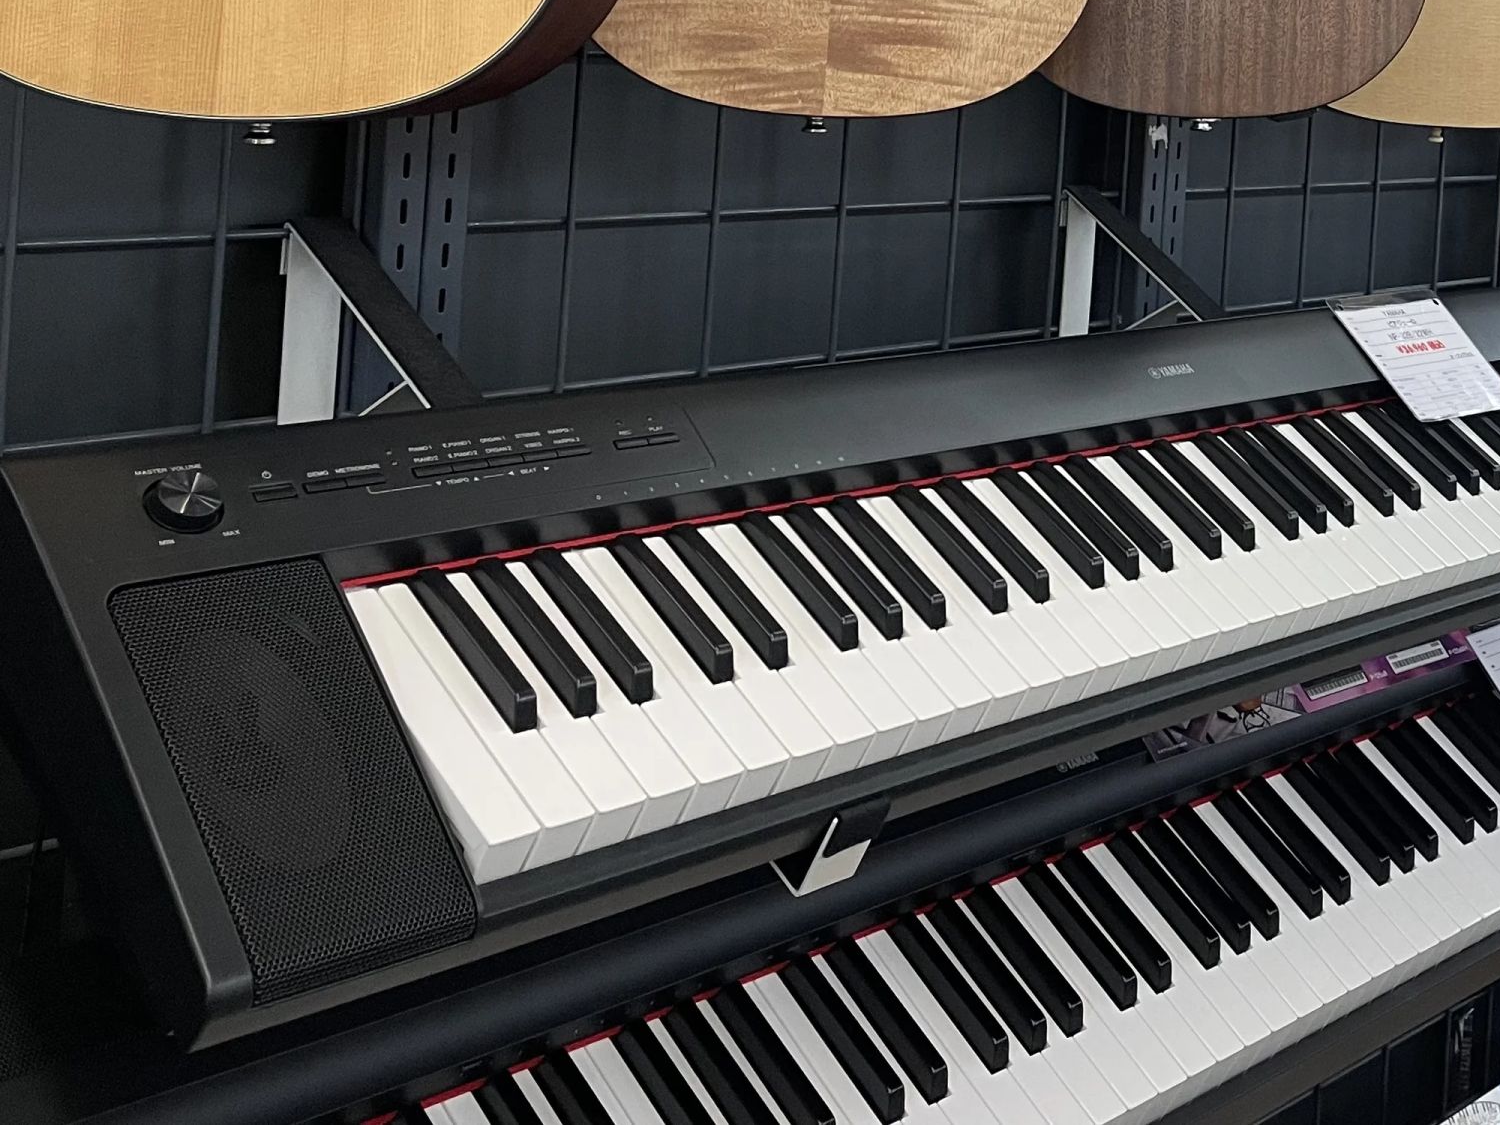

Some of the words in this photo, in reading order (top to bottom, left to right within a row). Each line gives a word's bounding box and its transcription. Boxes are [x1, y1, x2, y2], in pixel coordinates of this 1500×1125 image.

[1158, 363, 1195, 377] YAMAHA
[134, 467, 168, 476] MASTER
[170, 463, 202, 473] VOLUME
[222, 529, 241, 537] MAX
